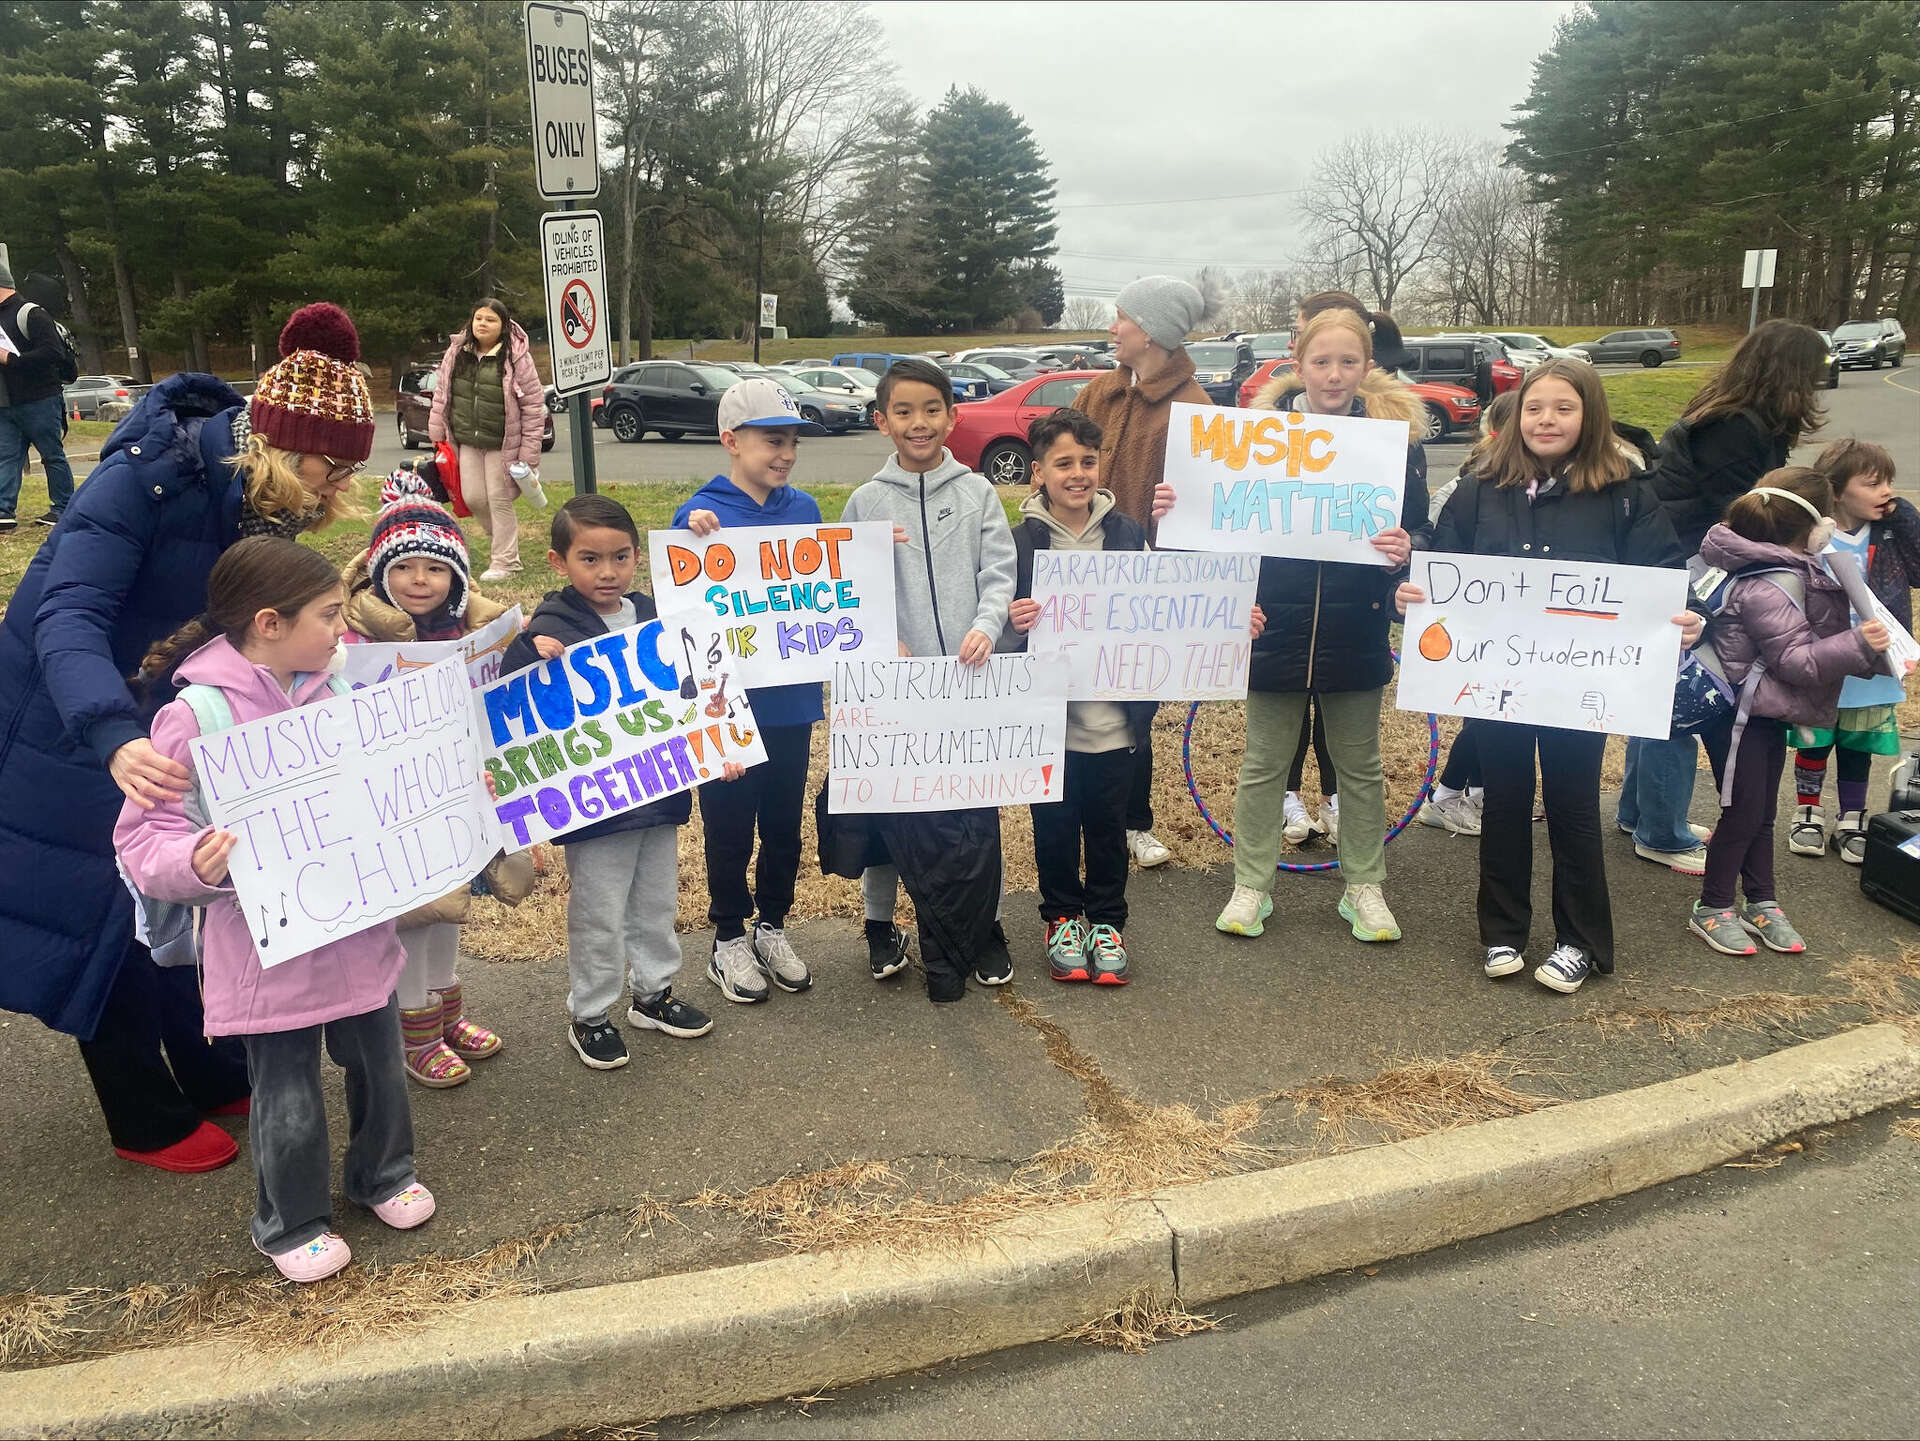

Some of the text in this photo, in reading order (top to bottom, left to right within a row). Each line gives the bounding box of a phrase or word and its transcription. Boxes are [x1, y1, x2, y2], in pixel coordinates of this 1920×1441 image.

[534, 44, 589, 87] BUSES
[545, 120, 586, 159] ONLY
[552, 229, 593, 246] IDLING OF
[554, 244, 594, 261] VEHICLES
[551, 259, 598, 277] PROHIBITED
[1211, 479, 1397, 542] MATTERS
[666, 528, 852, 587] DO NOT
[1035, 554, 1260, 586] PARAPROFESSIONALS
[705, 580, 860, 617] SILENCE
[1427, 561, 1532, 605] Don't
[1033, 593, 1246, 634] ARE ESSENTIAL
[777, 616, 863, 660] KIDS
[1506, 634, 1643, 668] Students!
[483, 620, 680, 748] MUSIC
[834, 655, 1036, 704] INSTRUMENTS
[1094, 641, 1171, 692] NEED
[1183, 641, 1250, 690] THEM
[200, 660, 467, 801] MUSIC DEVELOPS
[832, 707, 899, 728] ARE...
[484, 699, 674, 797] BRINGS US
[832, 724, 1054, 768] INSTRUMENTAL
[223, 739, 473, 871] THE WHOLE
[833, 764, 1054, 805] TO LEARNING!
[296, 815, 474, 923] CHILD
